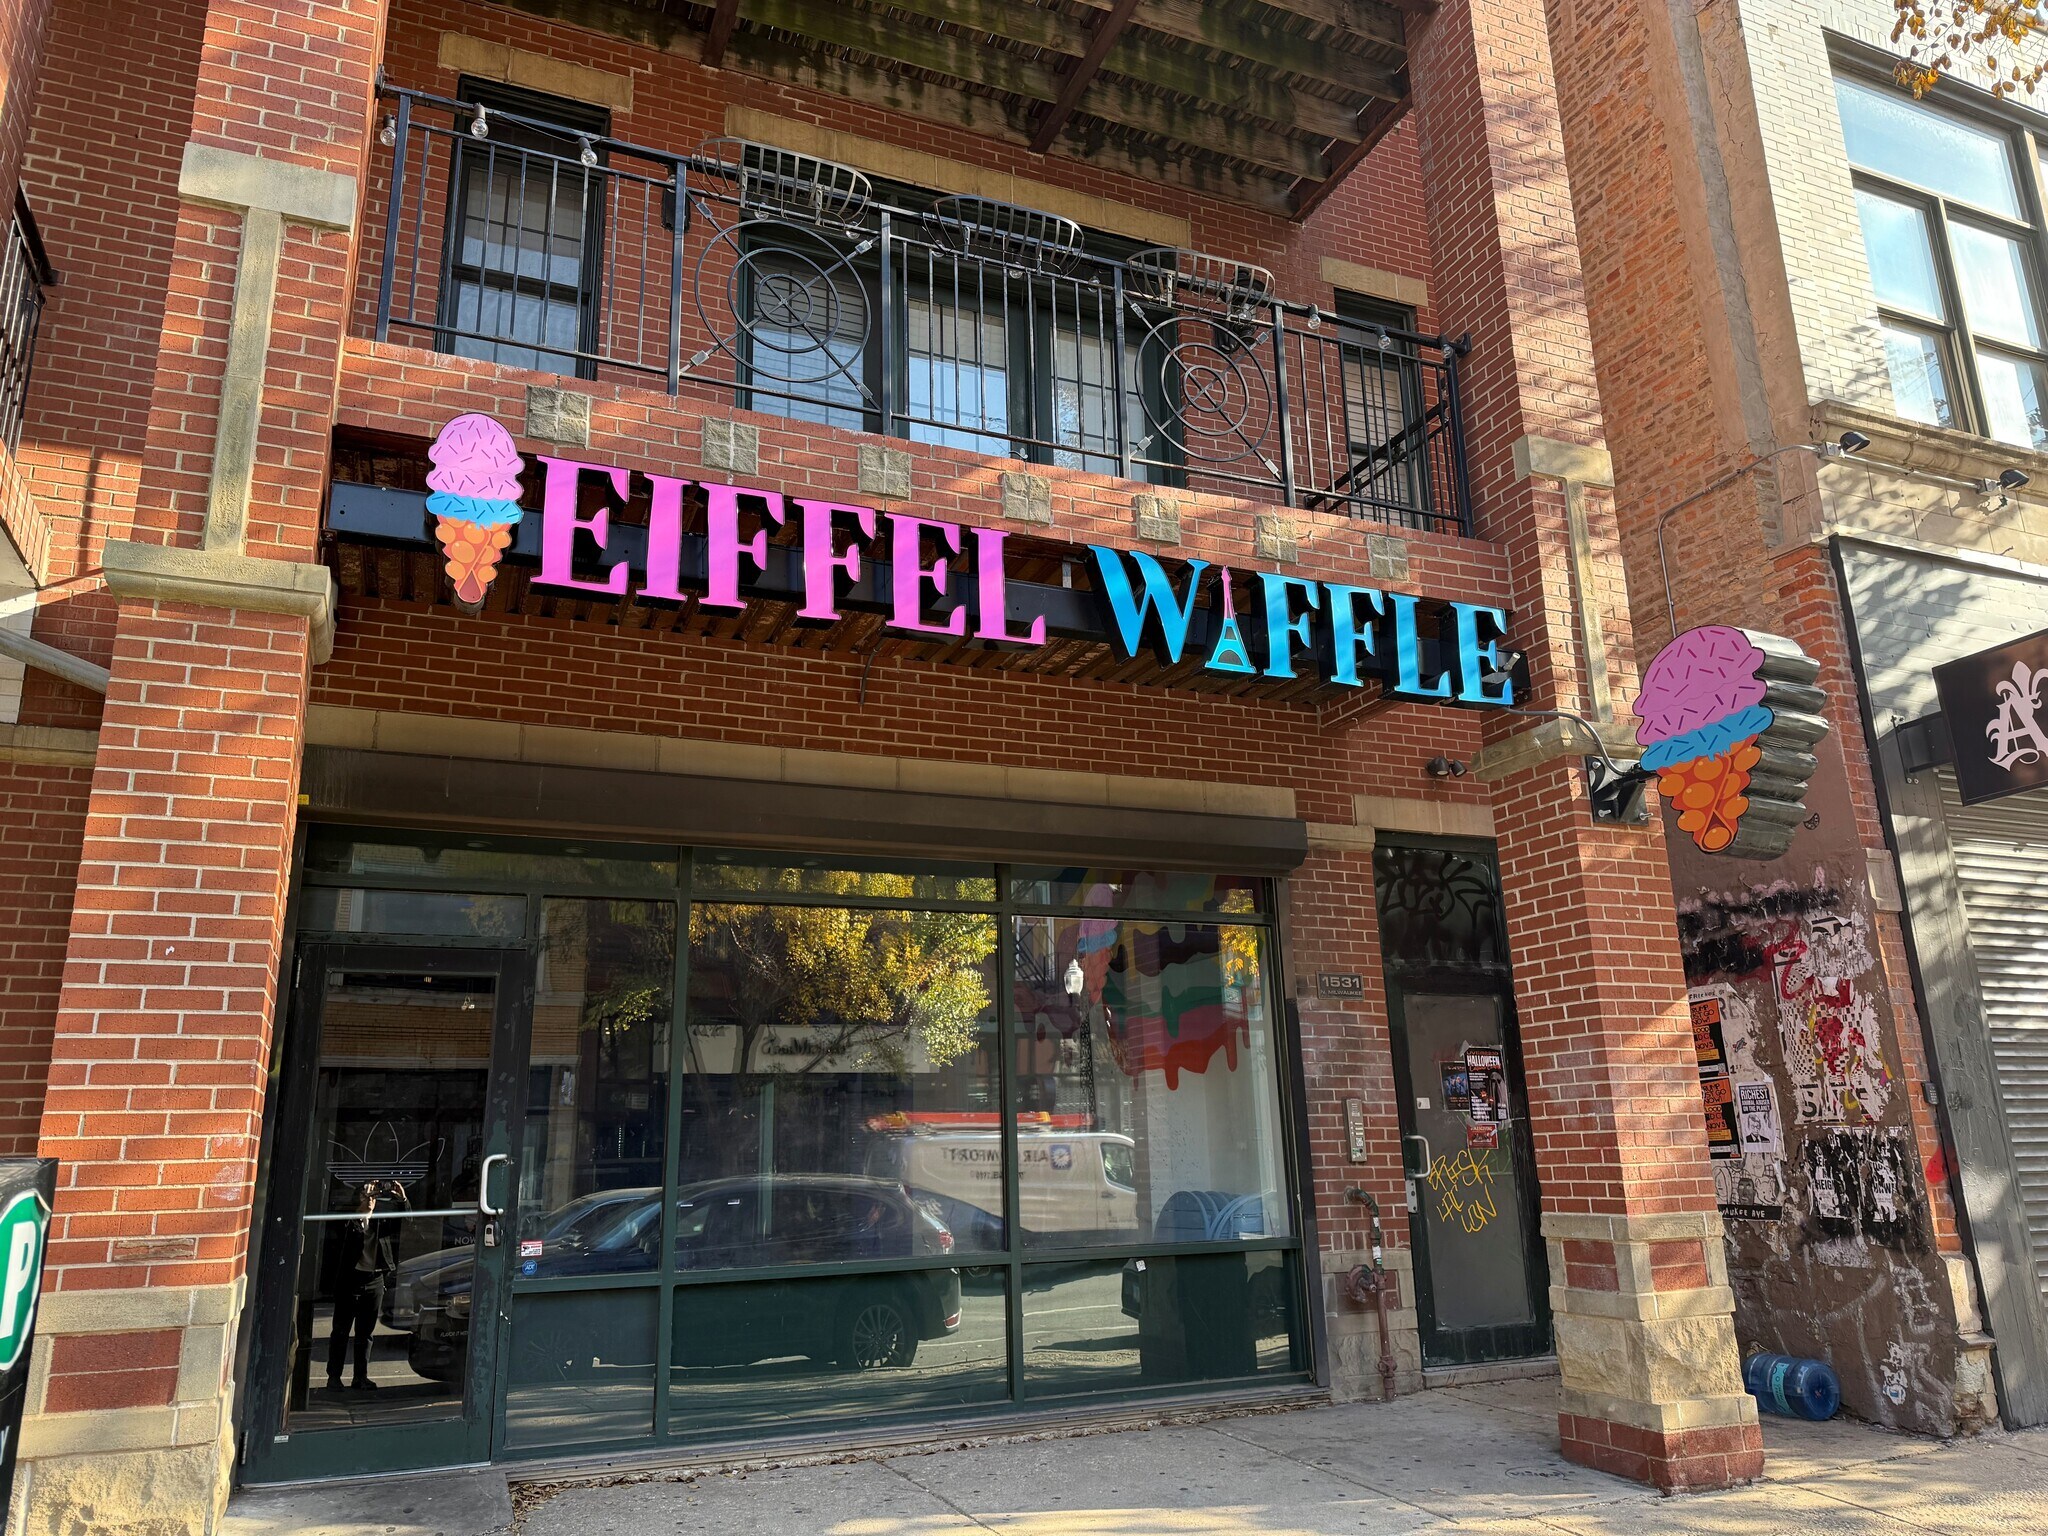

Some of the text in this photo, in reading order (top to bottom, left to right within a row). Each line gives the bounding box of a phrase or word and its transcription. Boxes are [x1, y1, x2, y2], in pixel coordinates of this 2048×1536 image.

[530, 455, 1514, 706] EIFFEL WAFFLE
[1322, 976, 1360, 989] 1531
[1703, 1008, 1715, 1017] GO
[1466, 1054, 1501, 1067] HALLOWEEN
[1715, 1088, 1727, 1096] GO
[1740, 1088, 1768, 1100] RICHEST
